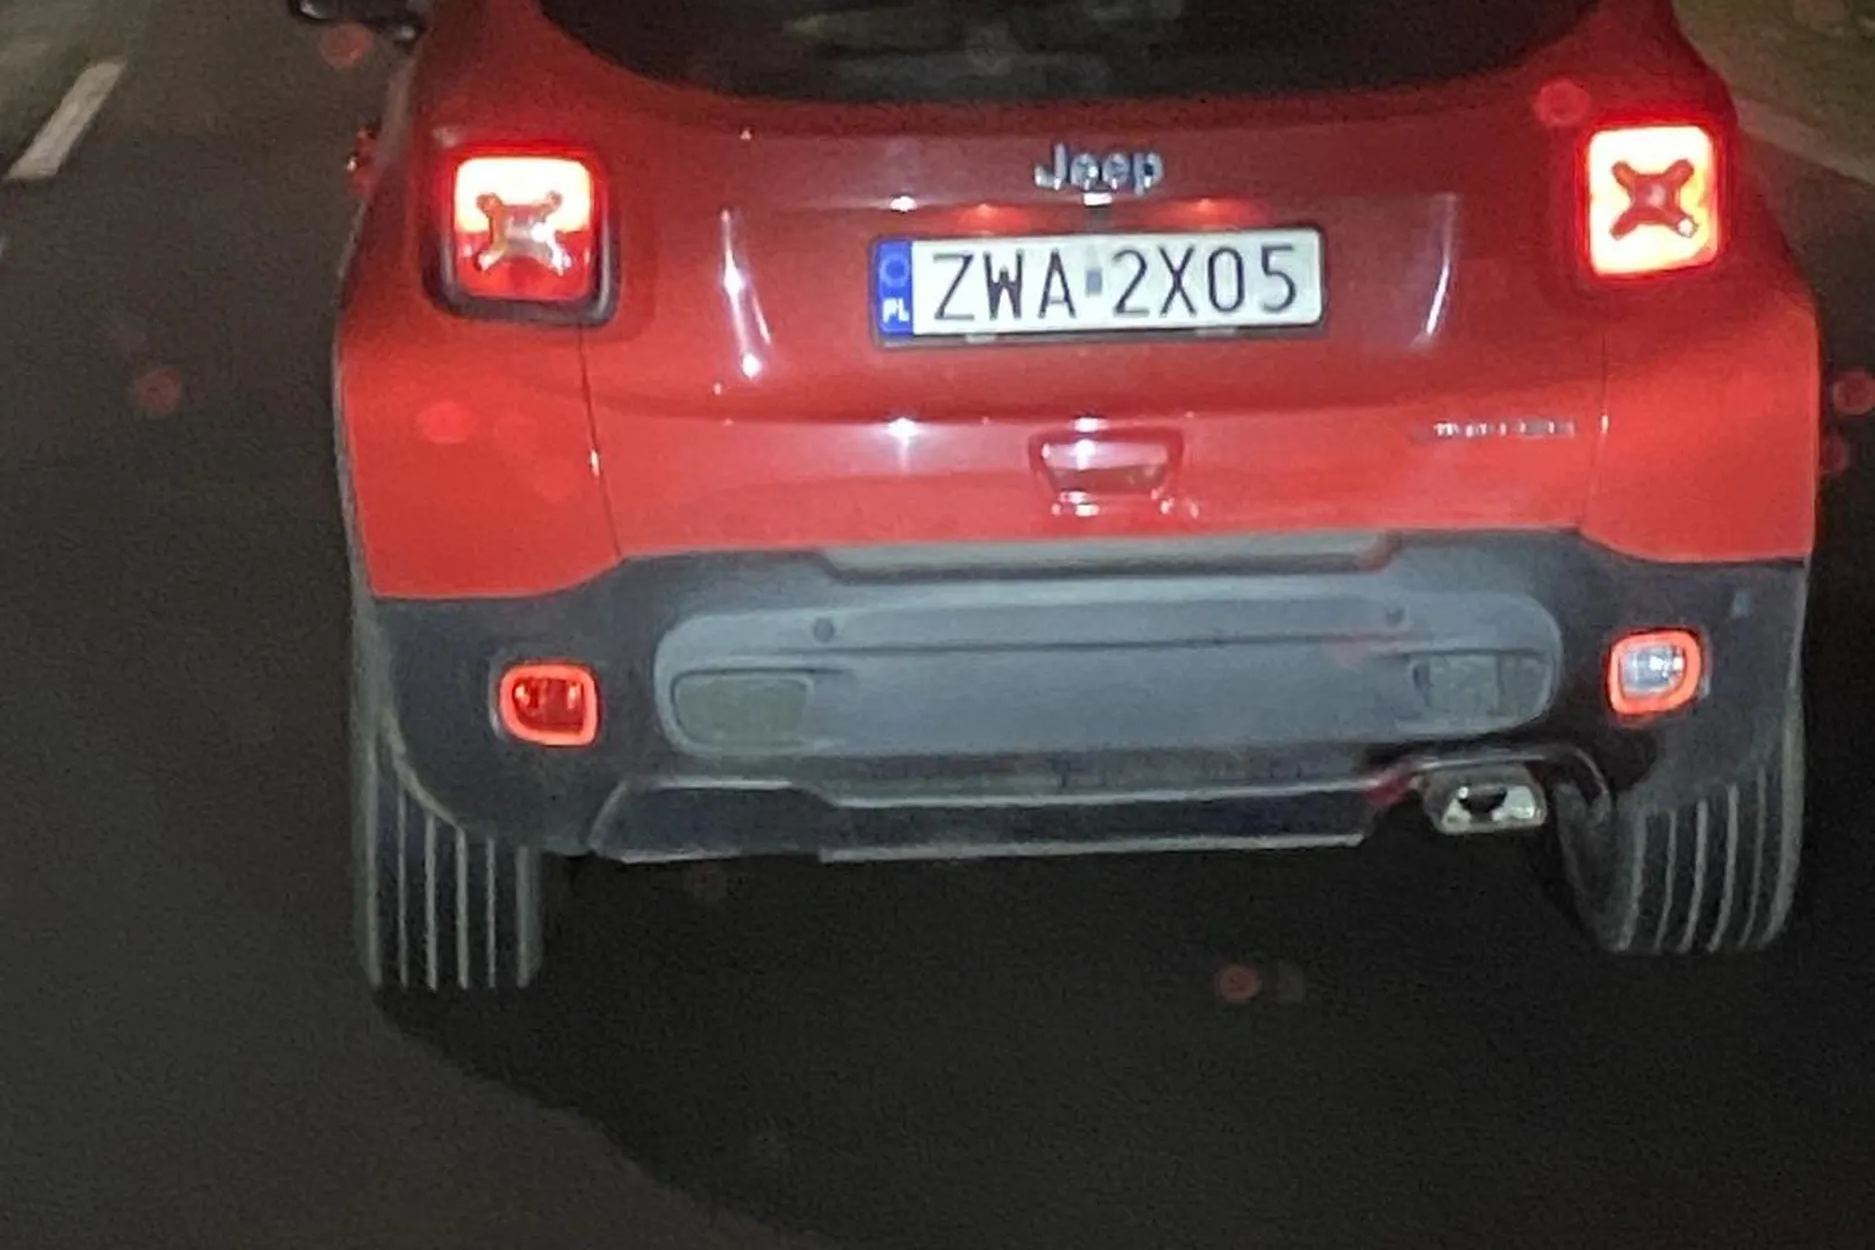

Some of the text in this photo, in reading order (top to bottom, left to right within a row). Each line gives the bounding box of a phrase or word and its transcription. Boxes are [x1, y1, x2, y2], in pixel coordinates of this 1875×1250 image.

[1034, 142, 1163, 196] Jeep
[933, 244, 1297, 321] ZWA 2X05
[882, 298, 910, 324] PL
